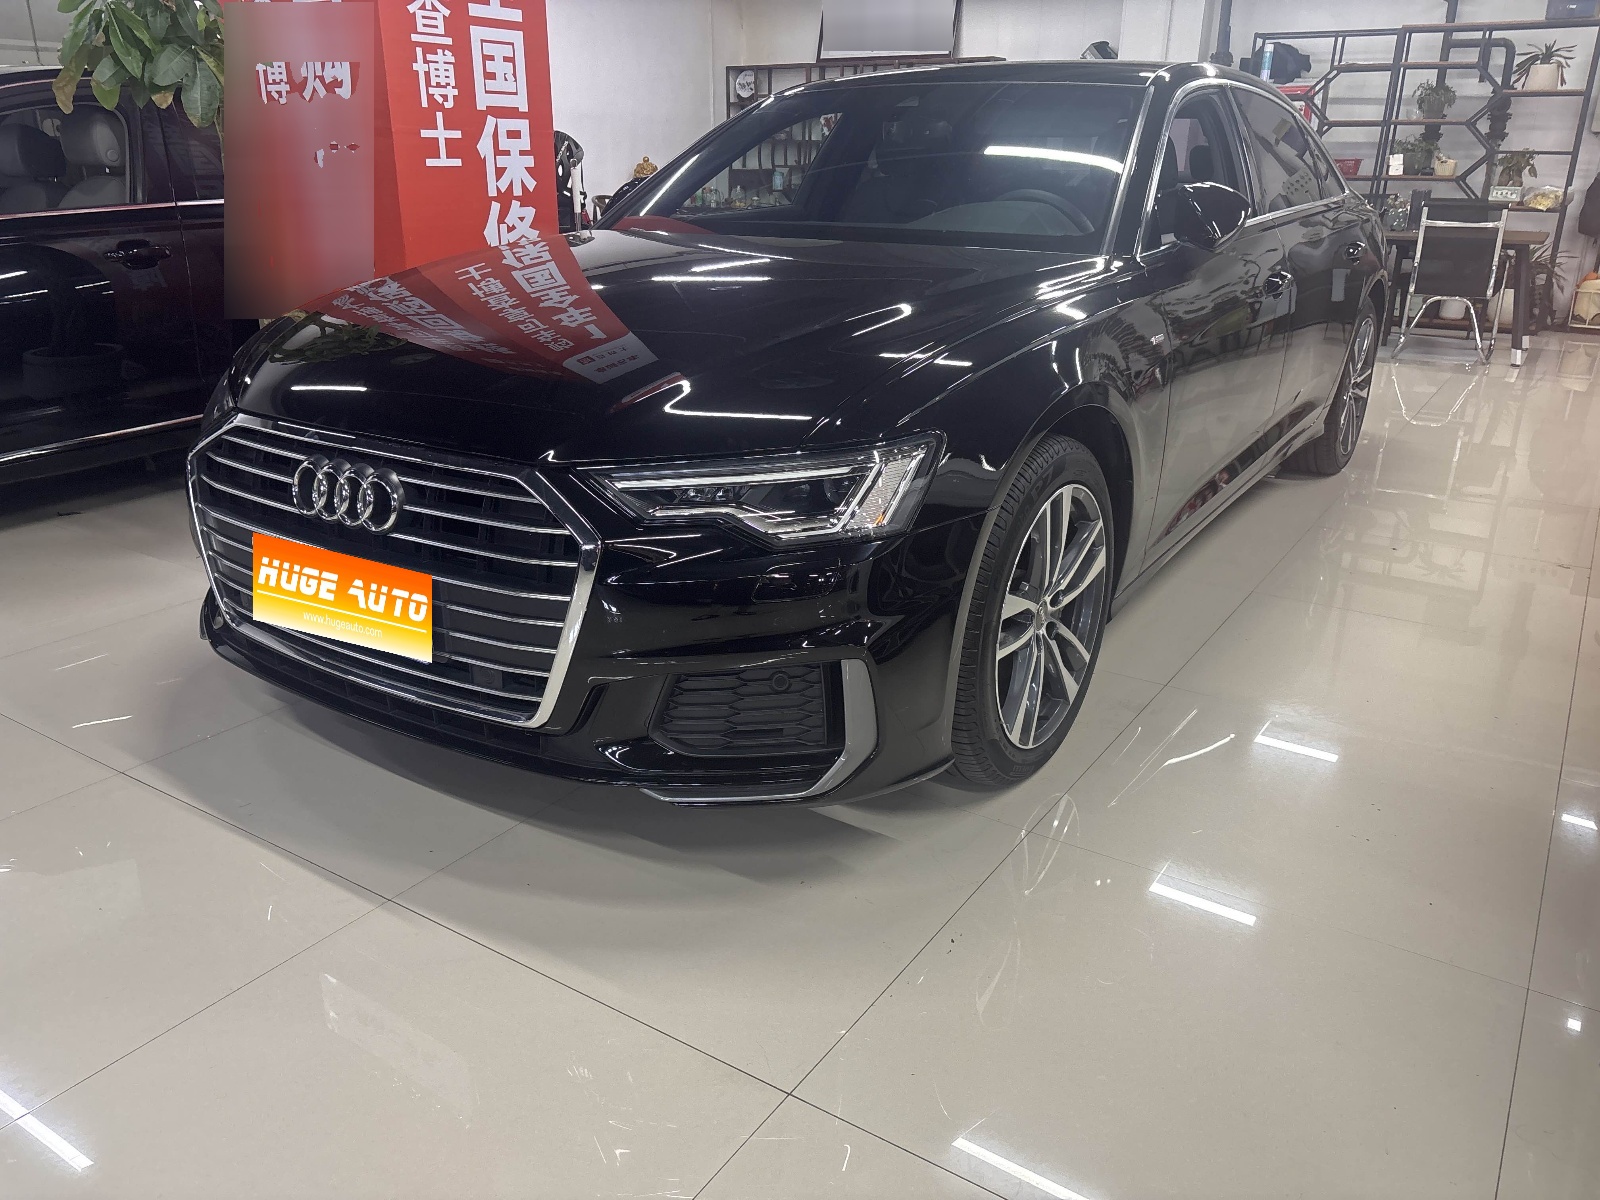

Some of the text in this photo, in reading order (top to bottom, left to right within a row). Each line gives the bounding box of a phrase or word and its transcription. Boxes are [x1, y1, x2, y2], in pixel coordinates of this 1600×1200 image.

[406, 0, 463, 167] 查博士
[468, 2, 540, 247] 国保修
